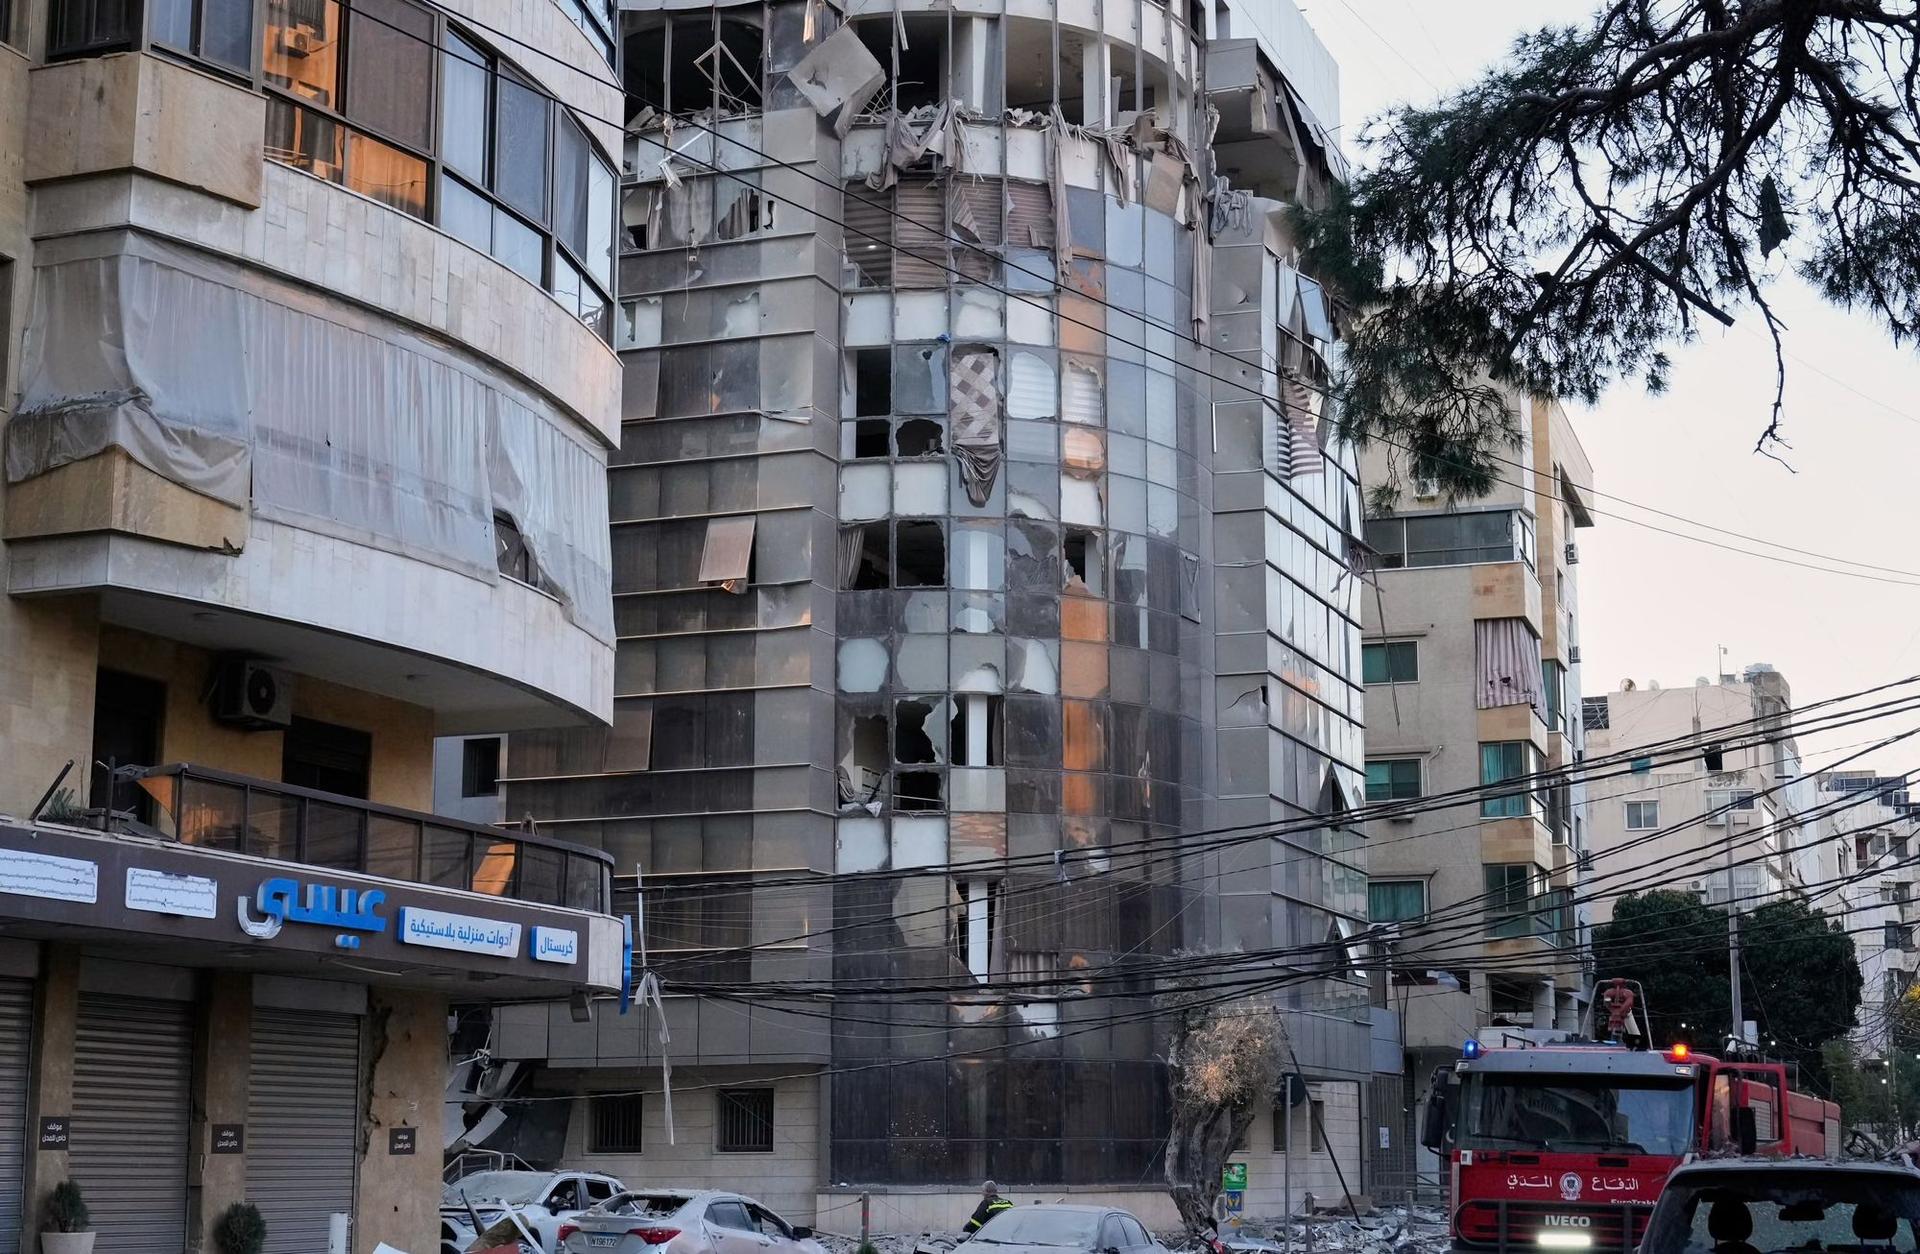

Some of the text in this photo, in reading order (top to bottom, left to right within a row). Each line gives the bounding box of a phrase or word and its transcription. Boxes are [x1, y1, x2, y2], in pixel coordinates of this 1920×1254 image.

[410, 918, 514, 949] أدوات منزلية بلاستيكية
[540, 936, 573, 957] كريستال
[1544, 1214, 1591, 1227] IVECO
